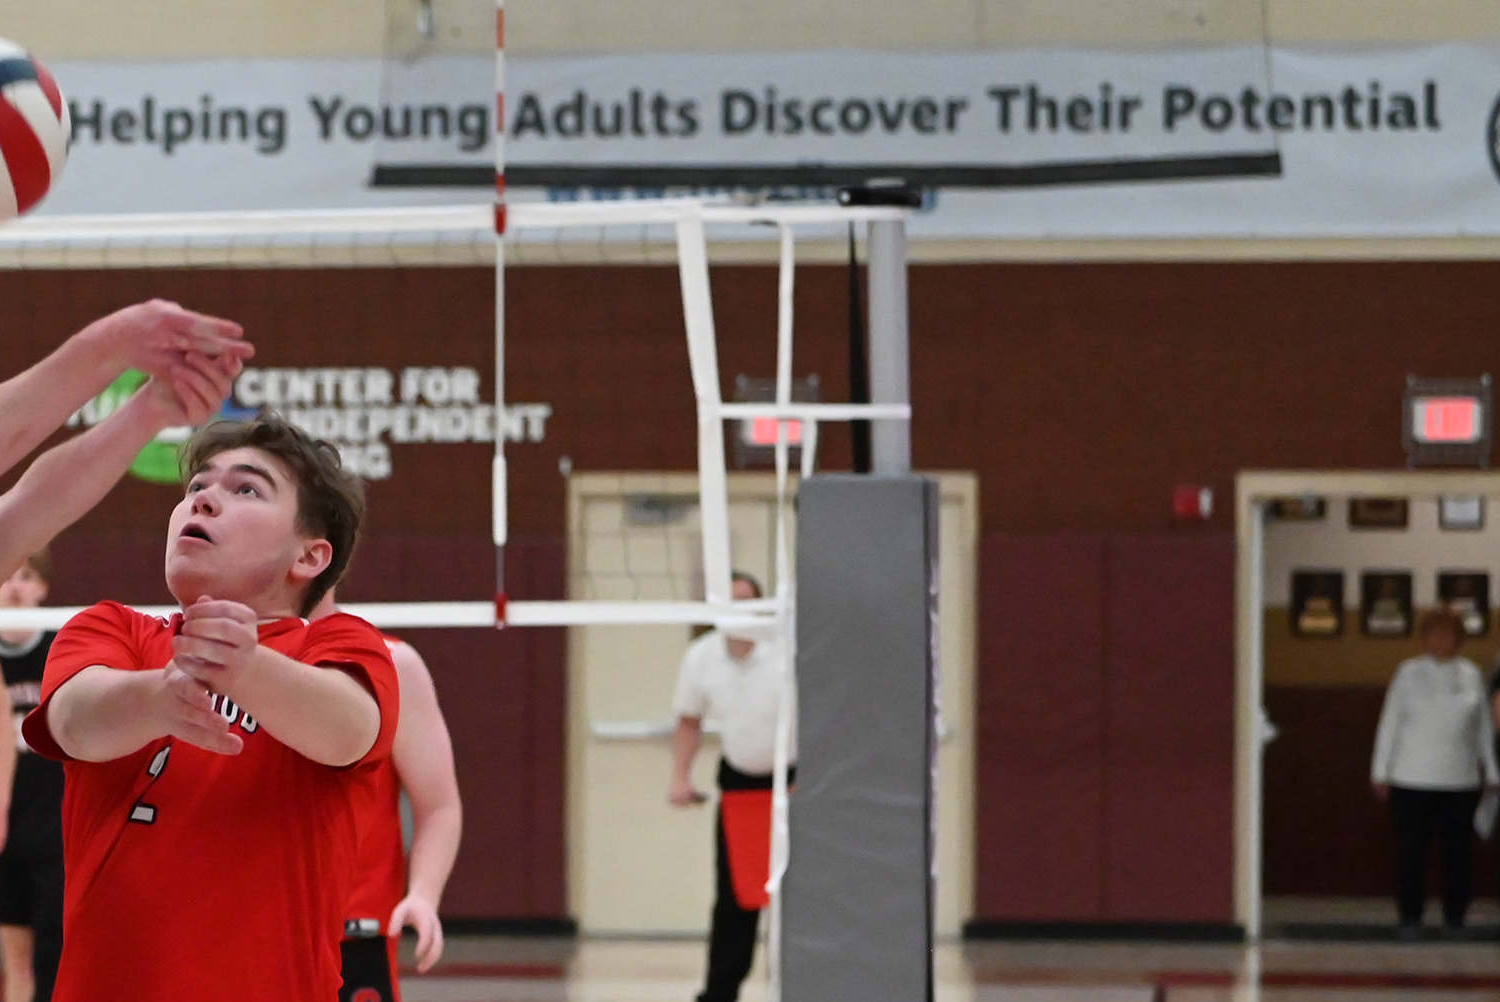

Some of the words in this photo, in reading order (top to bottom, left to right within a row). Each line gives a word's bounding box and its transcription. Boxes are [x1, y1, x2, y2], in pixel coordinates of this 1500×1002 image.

[69, 94, 287, 155] Helping
[309, 95, 489, 153] Young
[512, 87, 698, 138] Adults
[720, 86, 968, 136] Discover
[988, 81, 1143, 132] Their
[1163, 80, 1442, 132] Potential
[234, 366, 395, 408] CENTER
[400, 366, 480, 407] FOR
